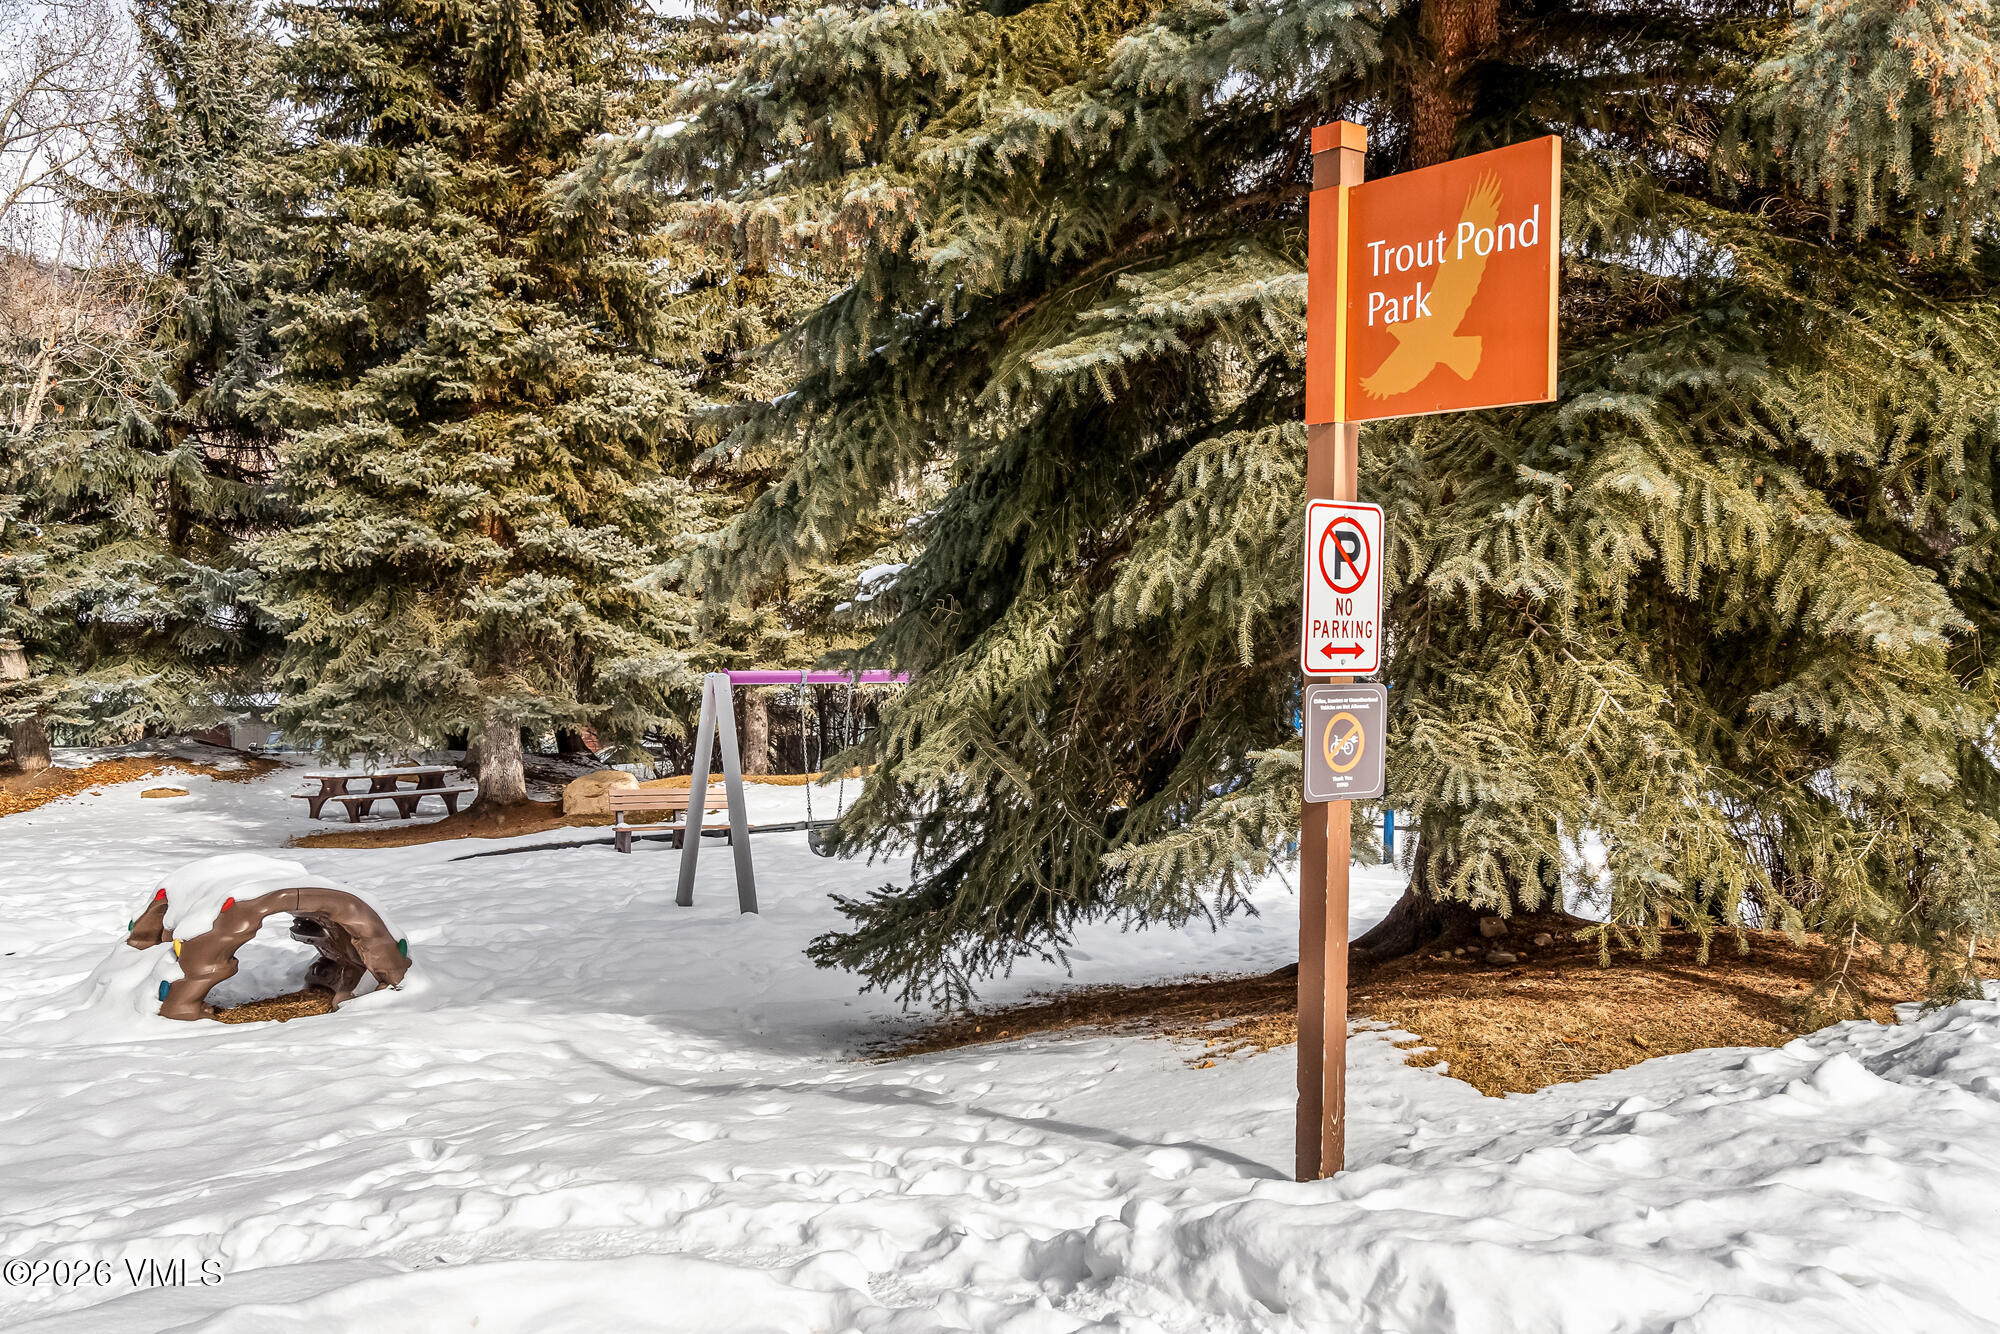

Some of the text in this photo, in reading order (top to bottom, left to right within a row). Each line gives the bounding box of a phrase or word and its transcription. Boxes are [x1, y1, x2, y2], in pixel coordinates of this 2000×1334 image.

[1367, 204, 1539, 277] Trout Pond
[1368, 281, 1432, 327] Park
[1335, 598, 1353, 616] NO
[1313, 620, 1373, 639] PARKING
